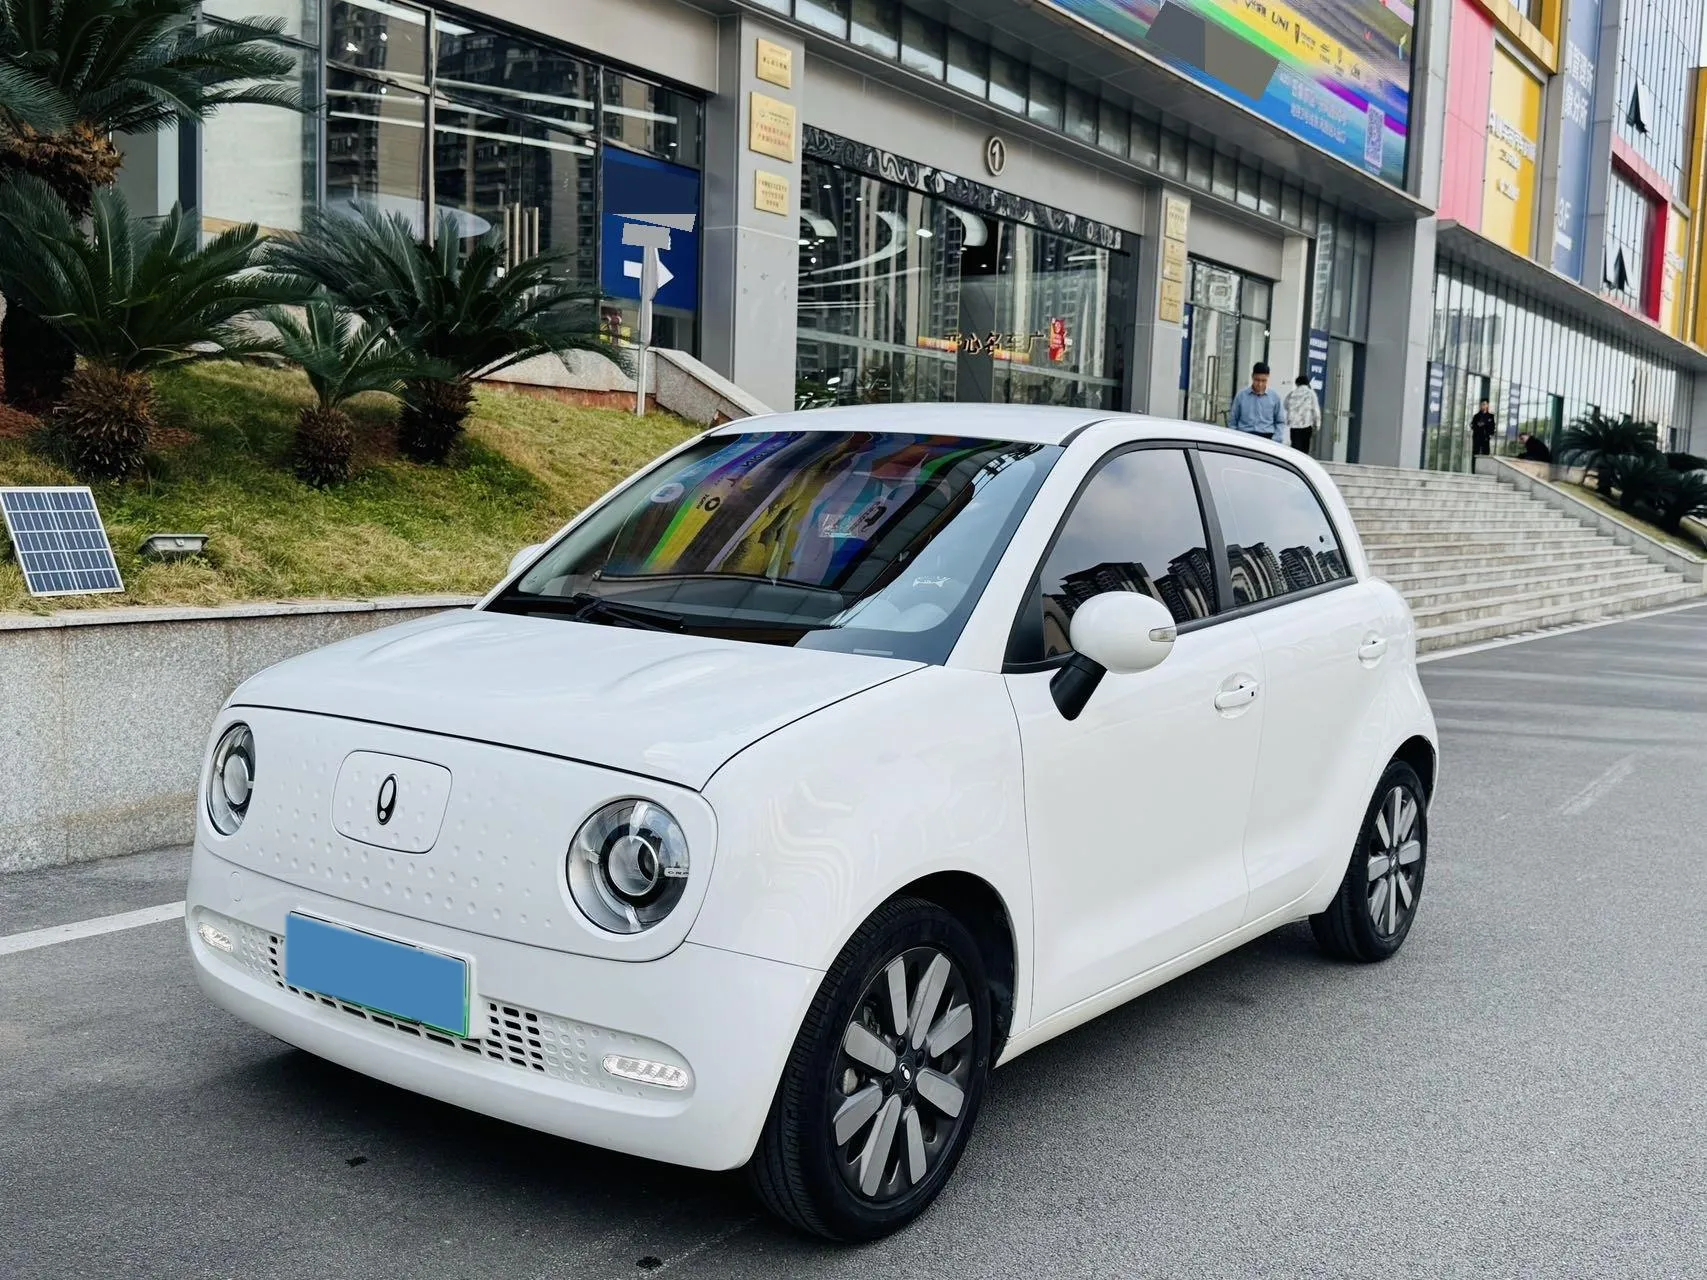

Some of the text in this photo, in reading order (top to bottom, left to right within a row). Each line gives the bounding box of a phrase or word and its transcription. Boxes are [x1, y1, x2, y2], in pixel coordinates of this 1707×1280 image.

[944, 330, 1072, 356] 开心名车广
